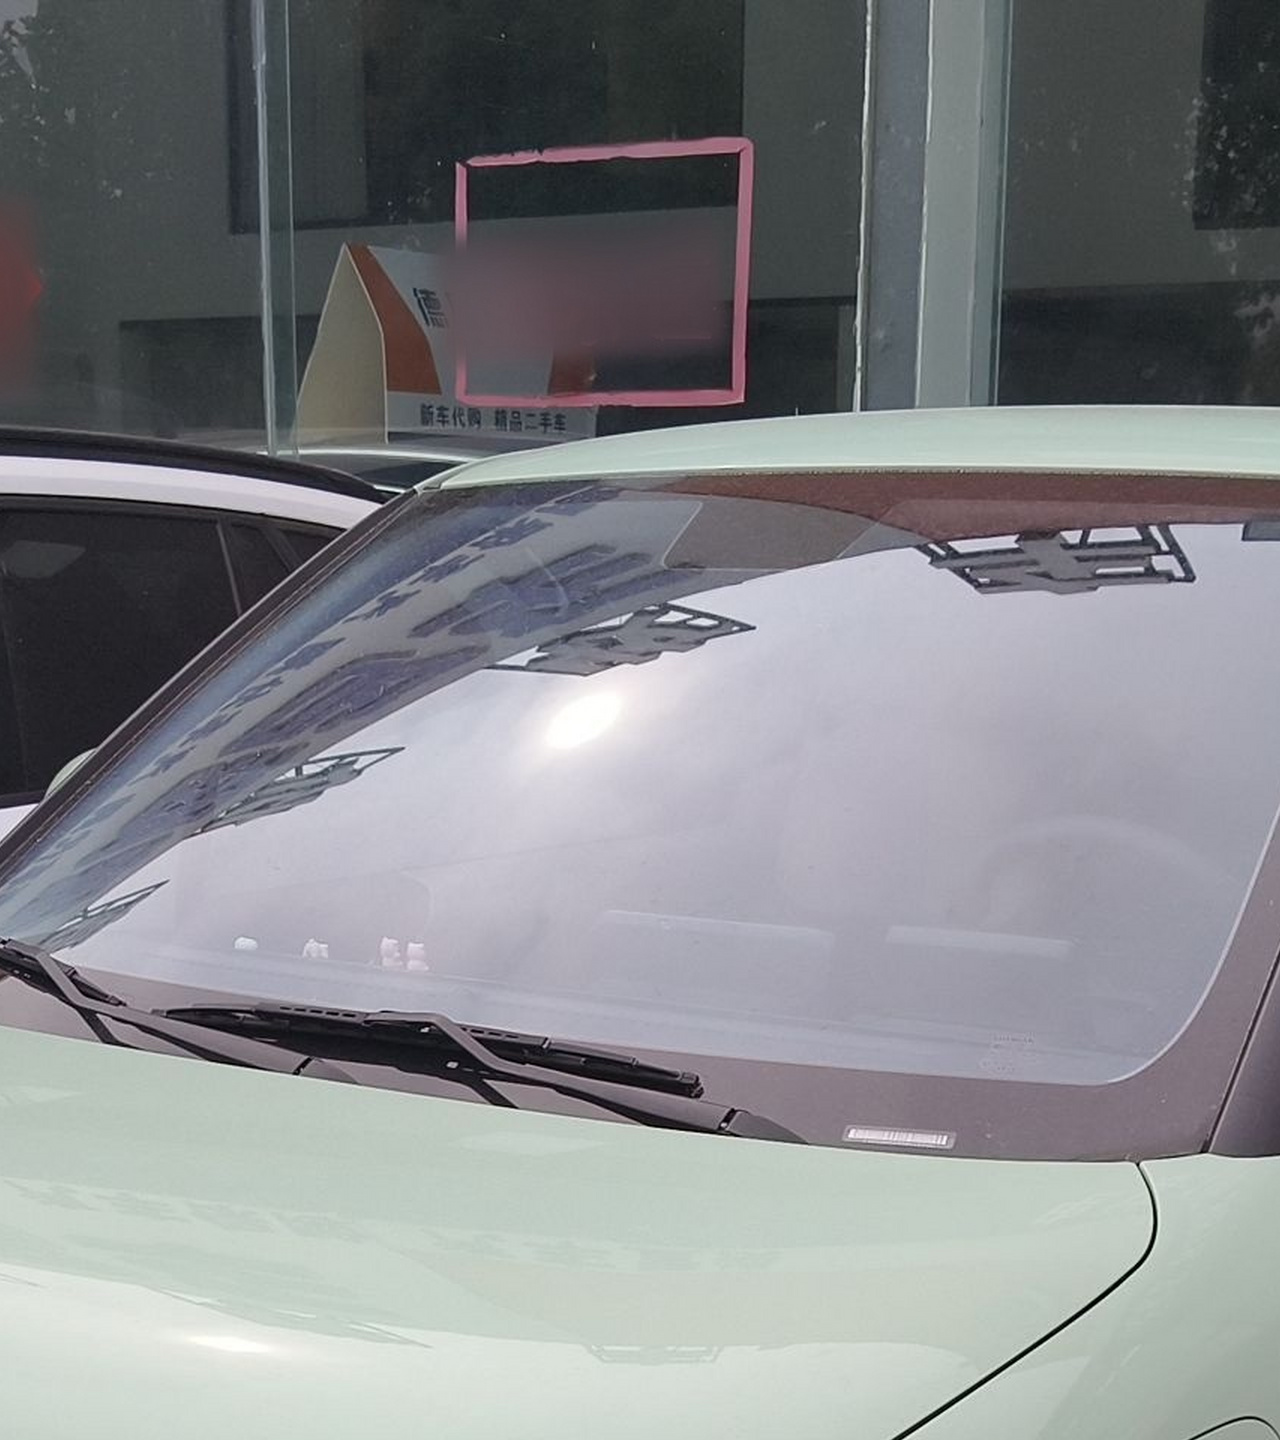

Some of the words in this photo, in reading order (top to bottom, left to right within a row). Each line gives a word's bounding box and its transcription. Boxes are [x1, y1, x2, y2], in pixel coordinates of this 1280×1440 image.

[420, 403, 482, 429] 新车代购
[494, 408, 568, 434] 精品二手车
